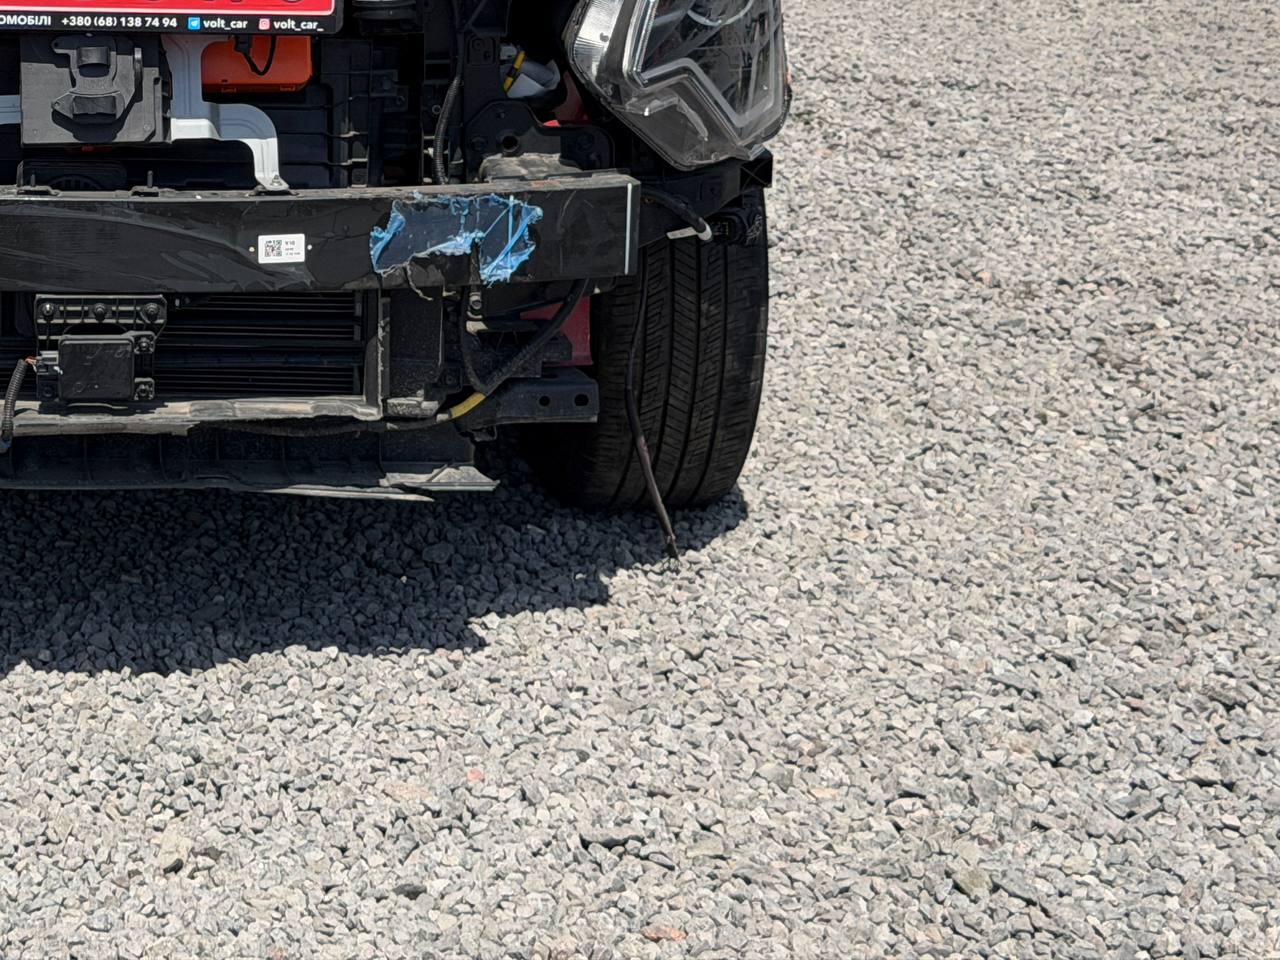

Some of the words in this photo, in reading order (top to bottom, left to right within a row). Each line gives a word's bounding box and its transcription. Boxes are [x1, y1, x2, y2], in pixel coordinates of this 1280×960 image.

[61, 16, 92, 27] +380
[93, 16, 118, 28] (68)
[120, 17, 142, 28] 138
[145, 17, 160, 28] 74
[162, 17, 178, 28] 94
[203, 18, 248, 30] volt_car
